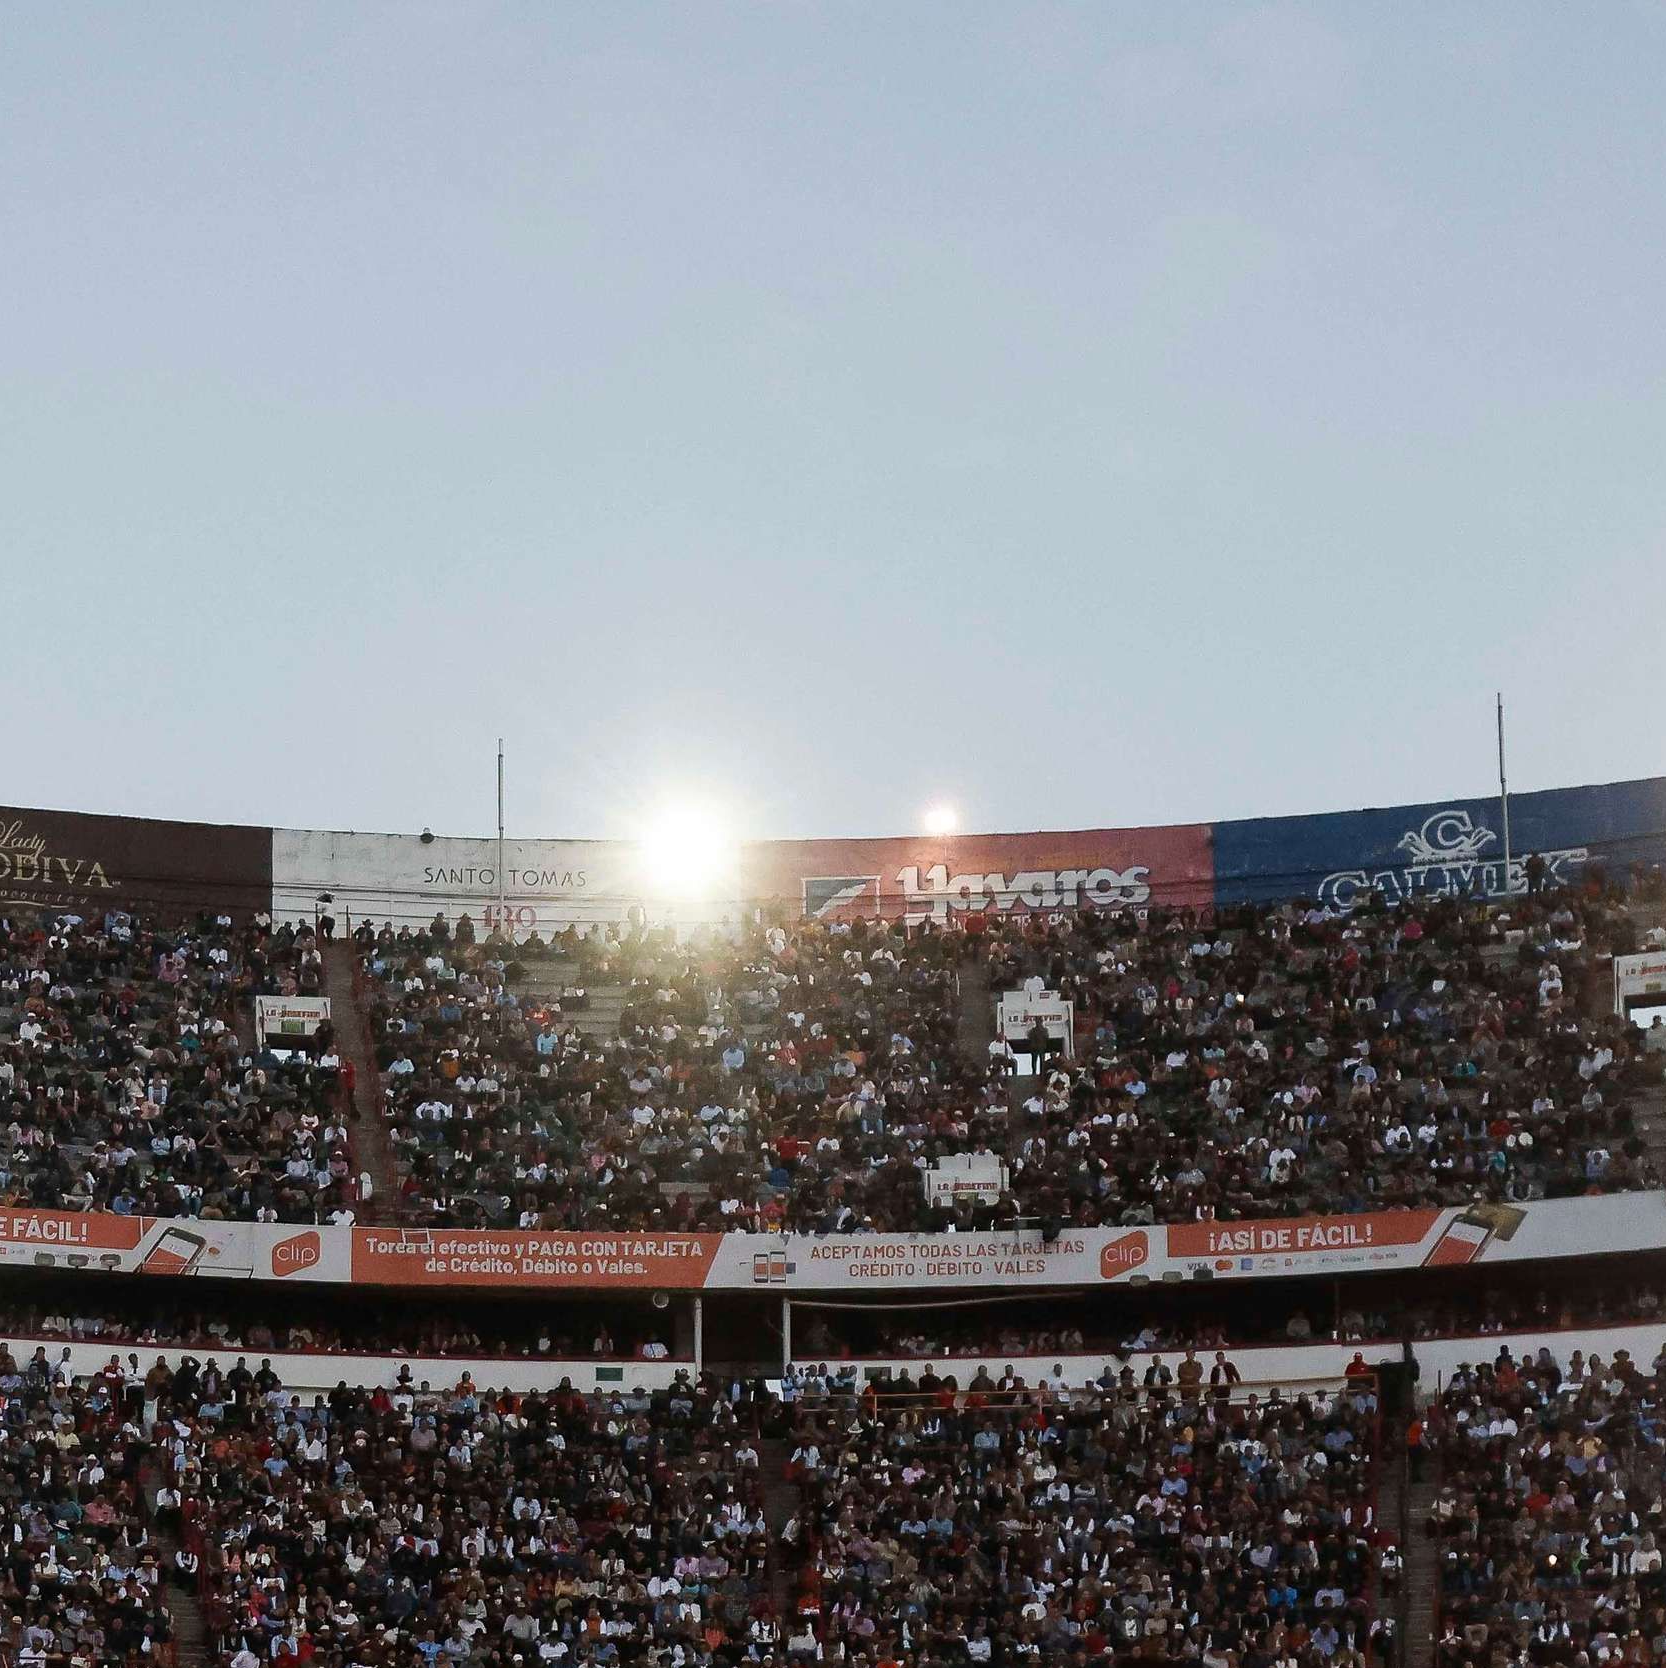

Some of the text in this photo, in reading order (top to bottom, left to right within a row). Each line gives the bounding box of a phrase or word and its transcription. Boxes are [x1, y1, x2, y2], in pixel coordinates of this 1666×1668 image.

[423, 867, 495, 885] SANTO
[12, 1215, 89, 1243] FÁCIL!
[1208, 1222, 1373, 1253] ¡ASÍ DE FÁCIL!
[276, 1243, 316, 1264] clip
[438, 1239, 511, 1257] efectivo
[514, 1243, 525, 1260] y
[528, 1240, 577, 1257] PAGA
[581, 1240, 617, 1257] CON
[621, 1240, 703, 1258] TARJETA
[810, 1239, 1085, 1261] ACEPTAMOS TODAS LAS TARJETAS
[1105, 1242, 1145, 1264] clip
[424, 1257, 648, 1276] de Crédito, Débito o Vales.
[993, 1259, 1046, 1275] VALES
